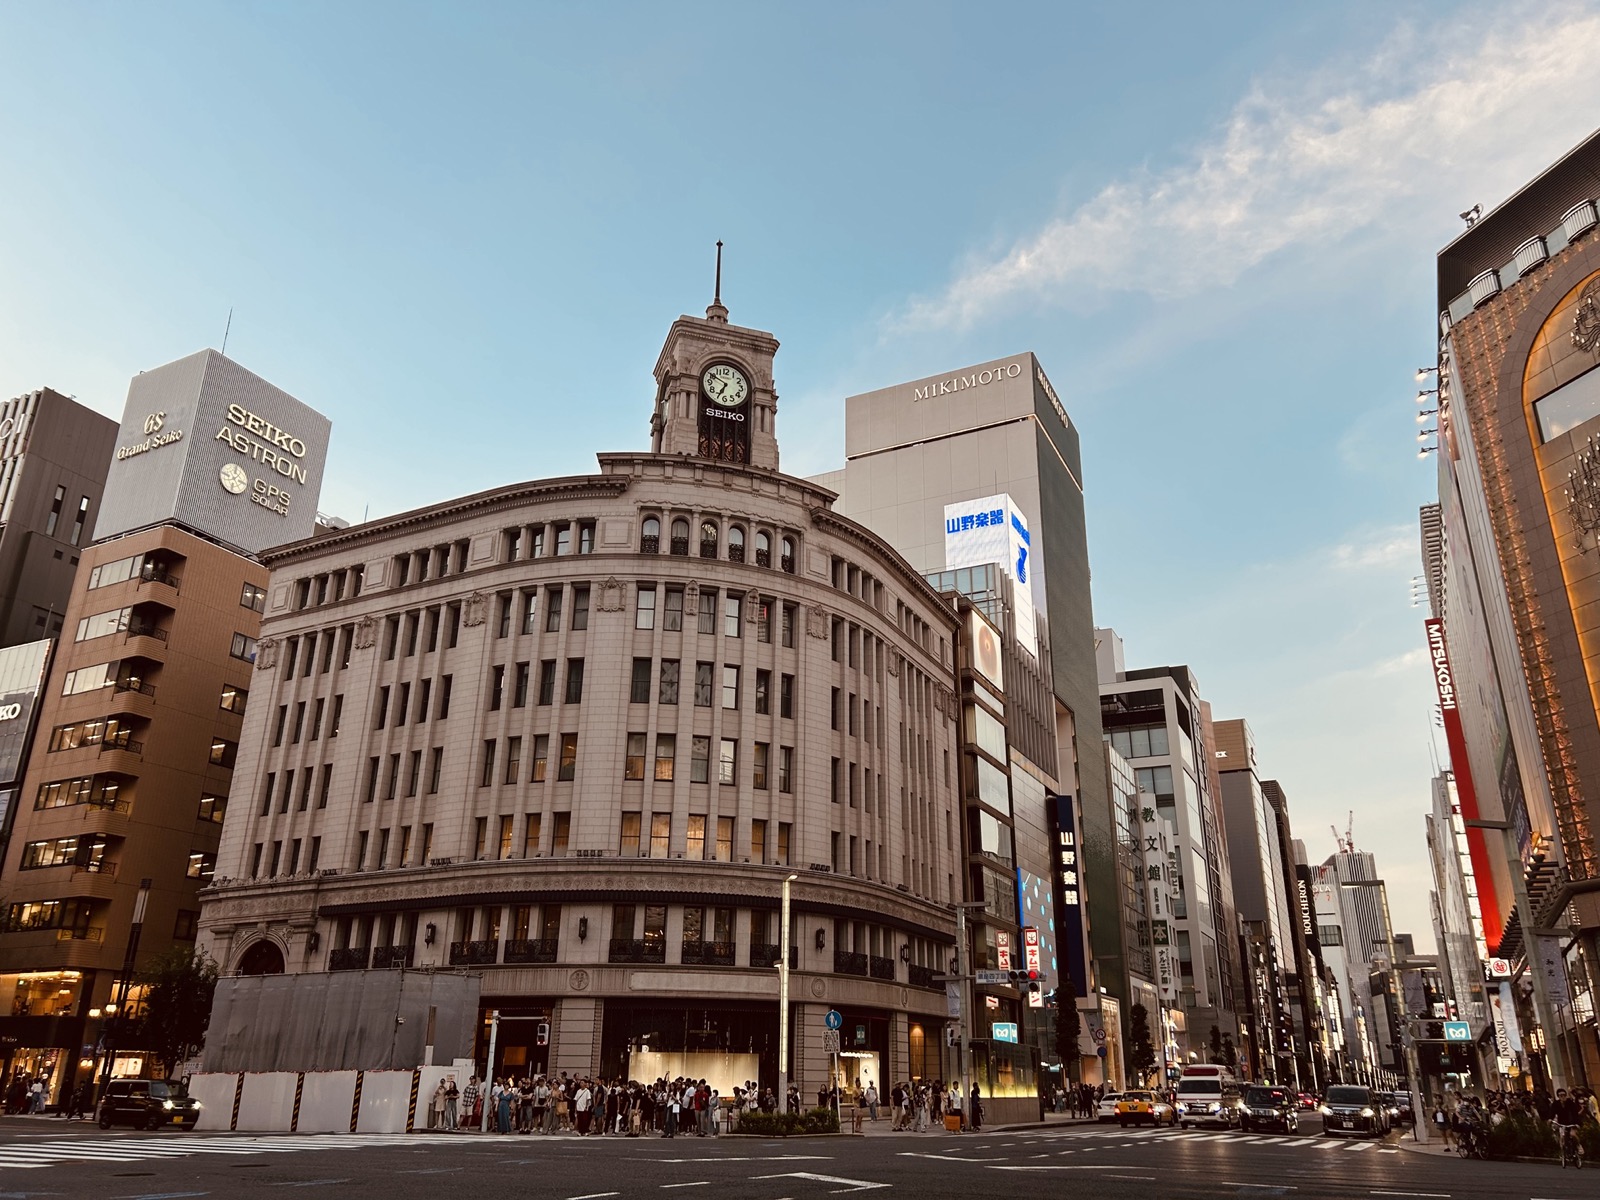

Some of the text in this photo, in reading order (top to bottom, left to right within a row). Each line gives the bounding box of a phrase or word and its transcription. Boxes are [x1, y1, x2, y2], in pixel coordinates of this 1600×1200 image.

[914, 363, 1022, 402] MIKIMOTO
[1037, 367, 1069, 429] MIKIMOTO
[227, 403, 306, 458] SEIKO
[706, 408, 744, 421] SEIKO
[117, 429, 183, 461] Grand Seiko
[214, 426, 307, 486] ASTRON
[251, 492, 289, 517] SOLAR
[253, 478, 291, 506] GPS
[946, 508, 1004, 534] 山野楽器
[1428, 624, 1456, 710] MITSUKOSHI
[1141, 806, 1161, 881] 教文館
[1060, 831, 1078, 905] 山野楽器
[1297, 880, 1313, 935] BOUCHERON
[1153, 924, 1167, 941] 本
